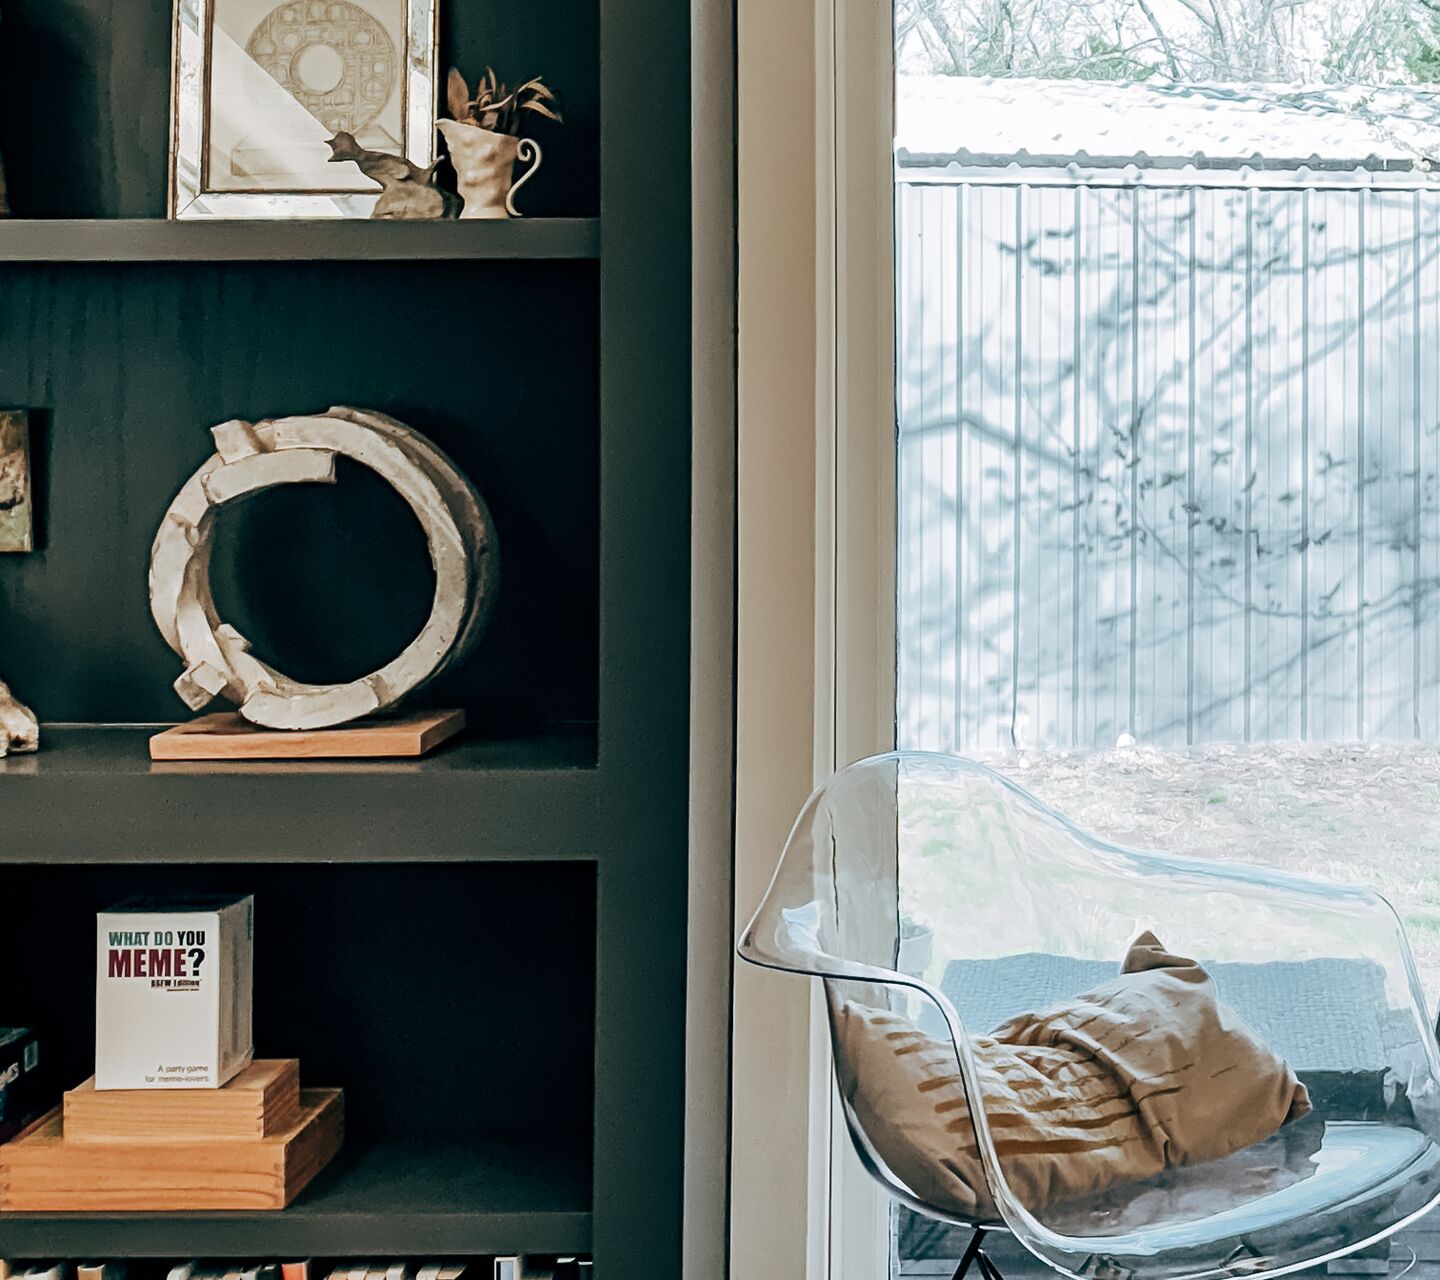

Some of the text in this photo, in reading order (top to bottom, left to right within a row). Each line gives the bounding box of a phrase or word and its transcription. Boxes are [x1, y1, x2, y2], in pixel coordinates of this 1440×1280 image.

[109, 930, 206, 947] WHAT DO YOU
[108, 948, 206, 978] MEME?
[166, 1066, 186, 1075] party
